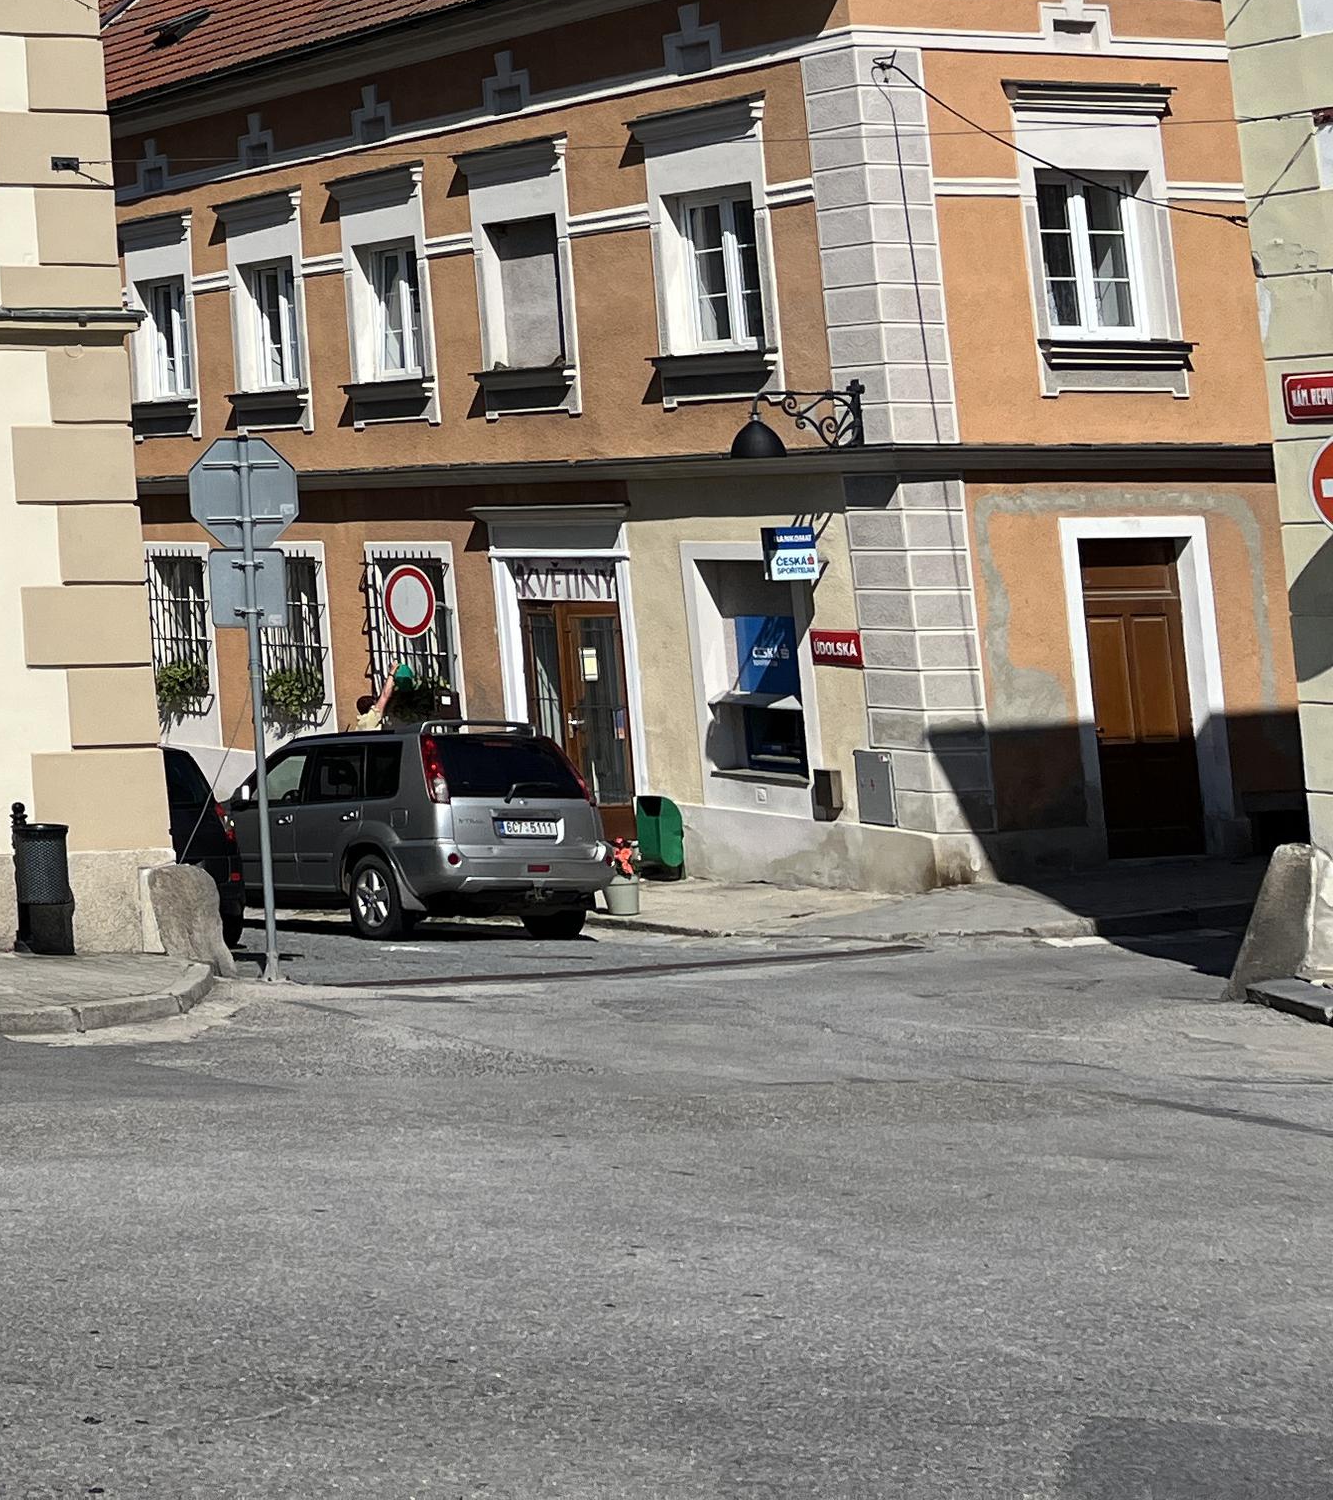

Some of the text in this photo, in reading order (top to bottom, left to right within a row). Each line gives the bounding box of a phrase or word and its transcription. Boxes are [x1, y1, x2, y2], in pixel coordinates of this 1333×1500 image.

[776, 555, 807, 567] ČESKÁ
[521, 561, 615, 599] KVĚTINY
[813, 638, 858, 657] ÚDOLSKÁ
